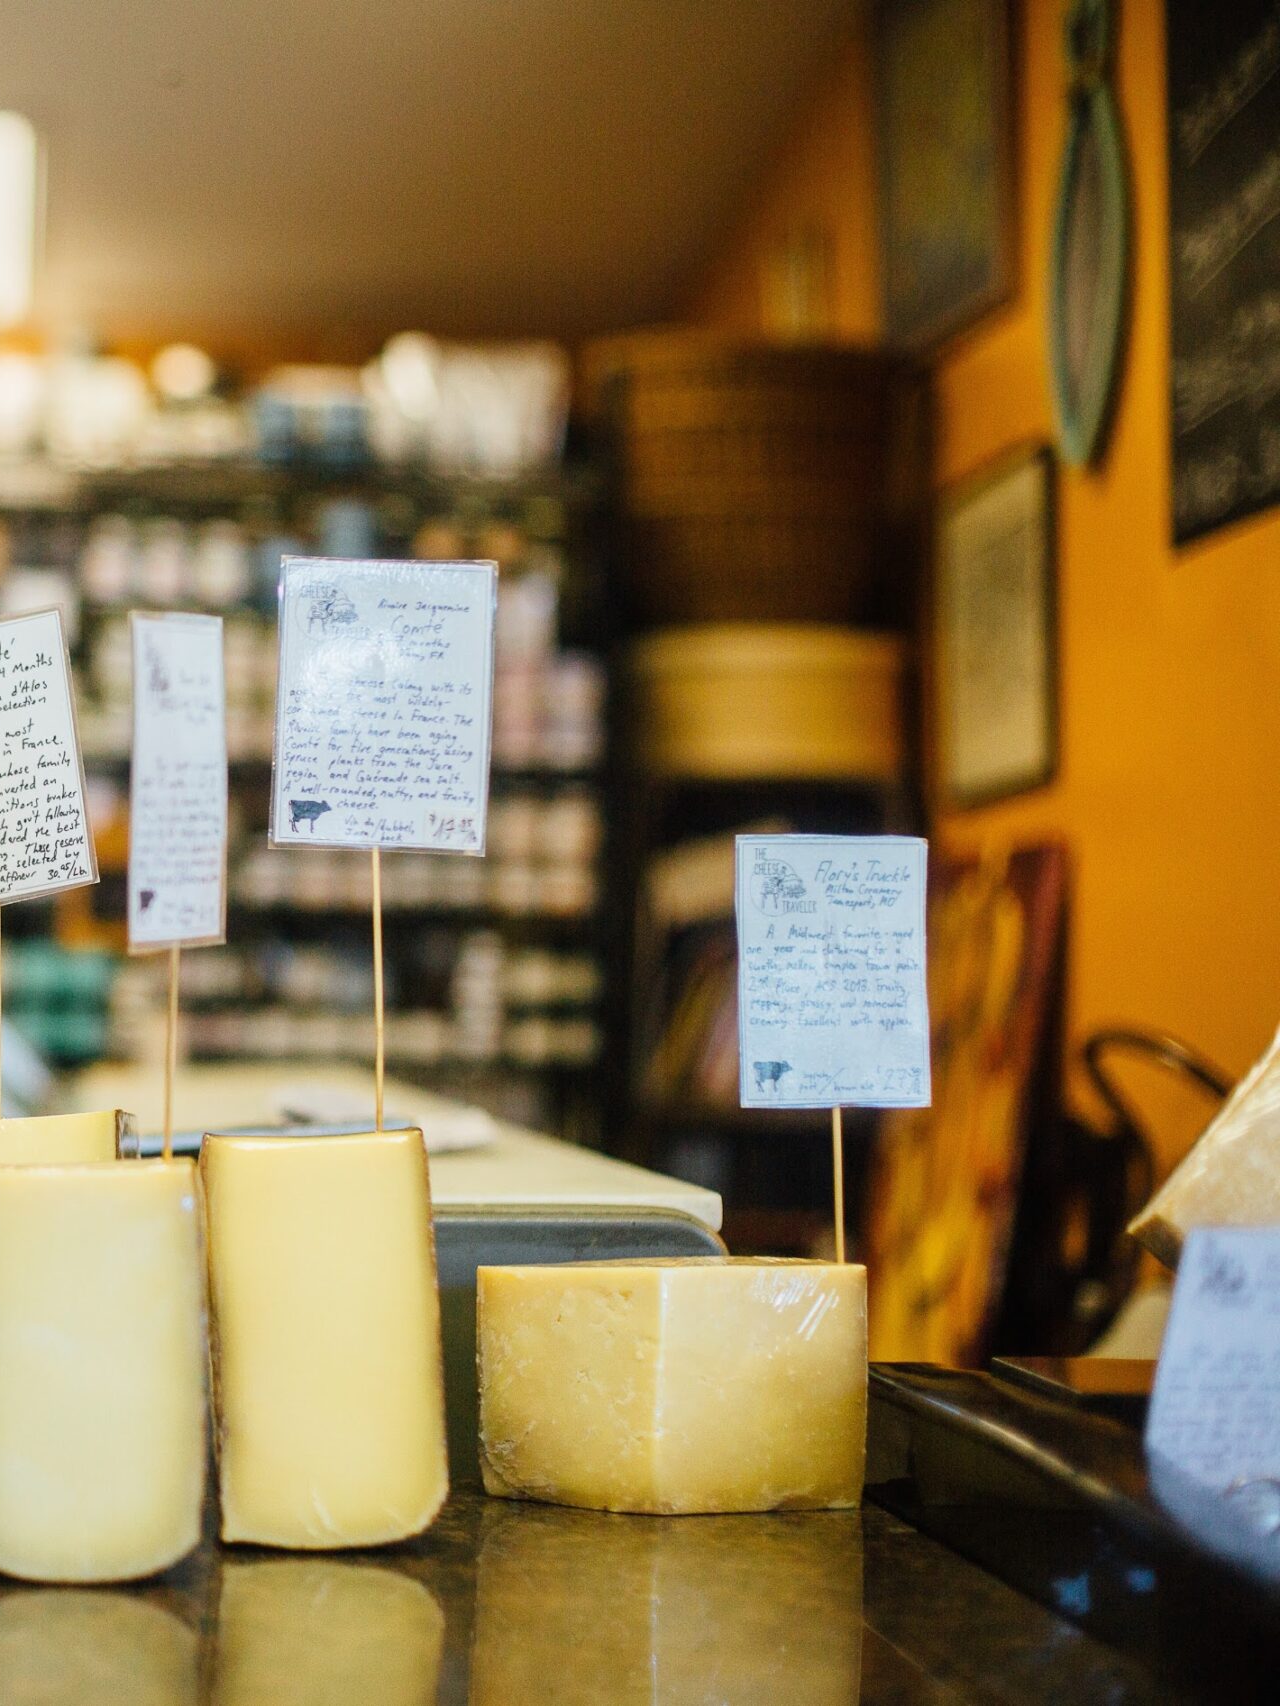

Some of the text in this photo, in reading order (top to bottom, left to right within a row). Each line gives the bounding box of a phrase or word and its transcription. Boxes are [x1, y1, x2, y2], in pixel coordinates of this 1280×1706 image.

[5, 717, 34, 737] most
[397, 727, 420, 739] been
[2, 742, 12, 756] in
[0, 765, 29, 778] whose
[36, 750, 70, 768] family
[42, 778, 56, 786] an
[46, 783, 77, 803] bunker
[45, 804, 80, 822] following
[35, 826, 50, 837] the
[56, 818, 80, 833] best
[16, 851, 56, 868] selected
[64, 850, 79, 858] by
[754, 847, 767, 861] THE
[782, 900, 817, 913] TRAVELER
